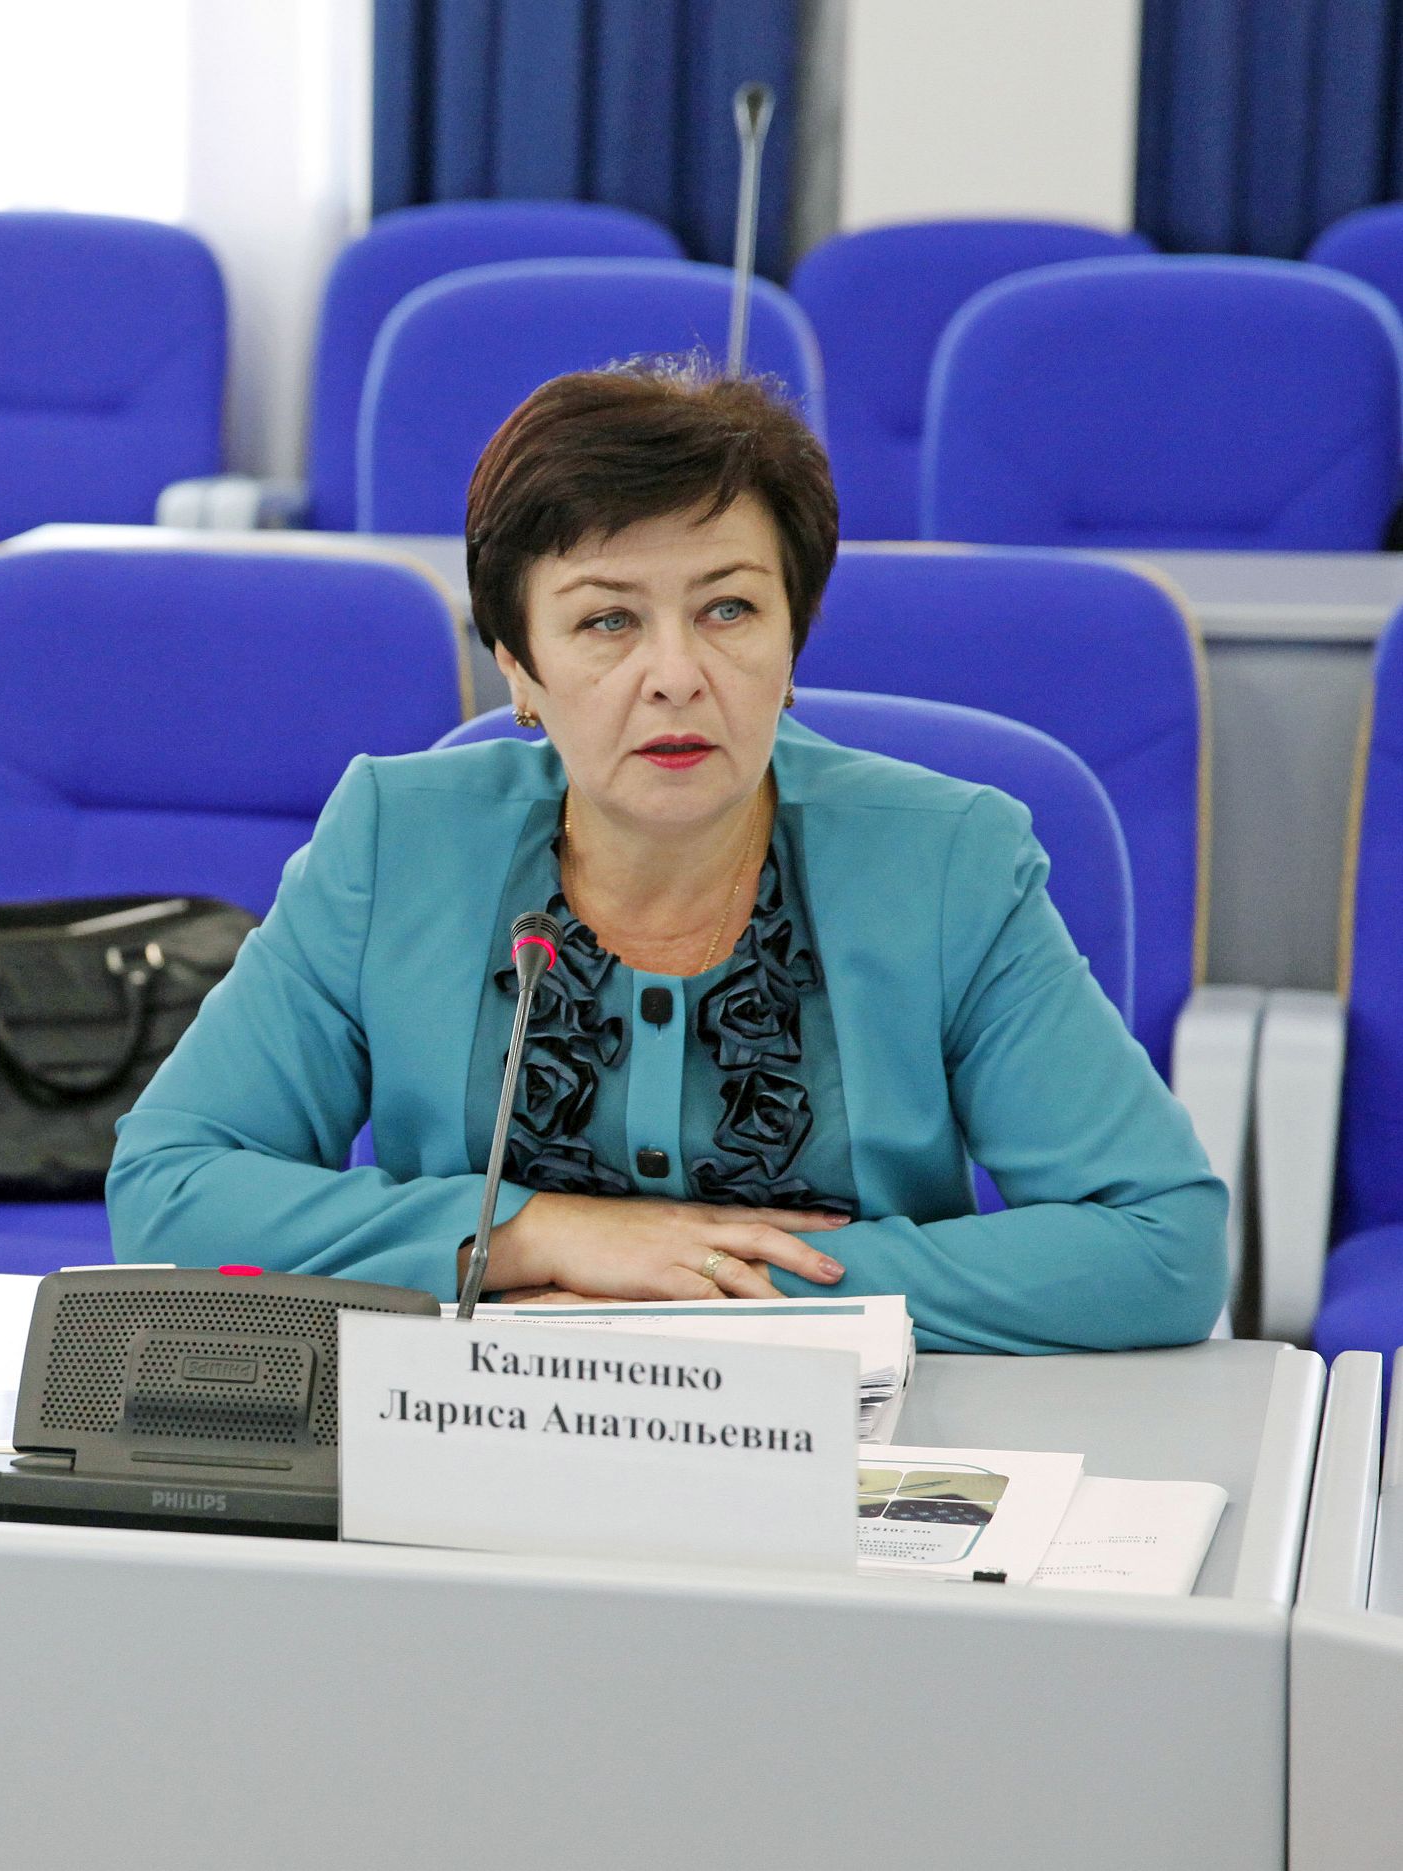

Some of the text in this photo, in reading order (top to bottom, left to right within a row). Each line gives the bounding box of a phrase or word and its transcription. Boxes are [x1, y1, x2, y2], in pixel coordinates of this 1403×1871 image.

[188, 1360, 252, 1378] PHILIPS
[469, 1341, 723, 1392] Калинченко
[379, 1388, 815, 1454] Лариса Анатольевна
[152, 1490, 227, 1512] PHILIPS
